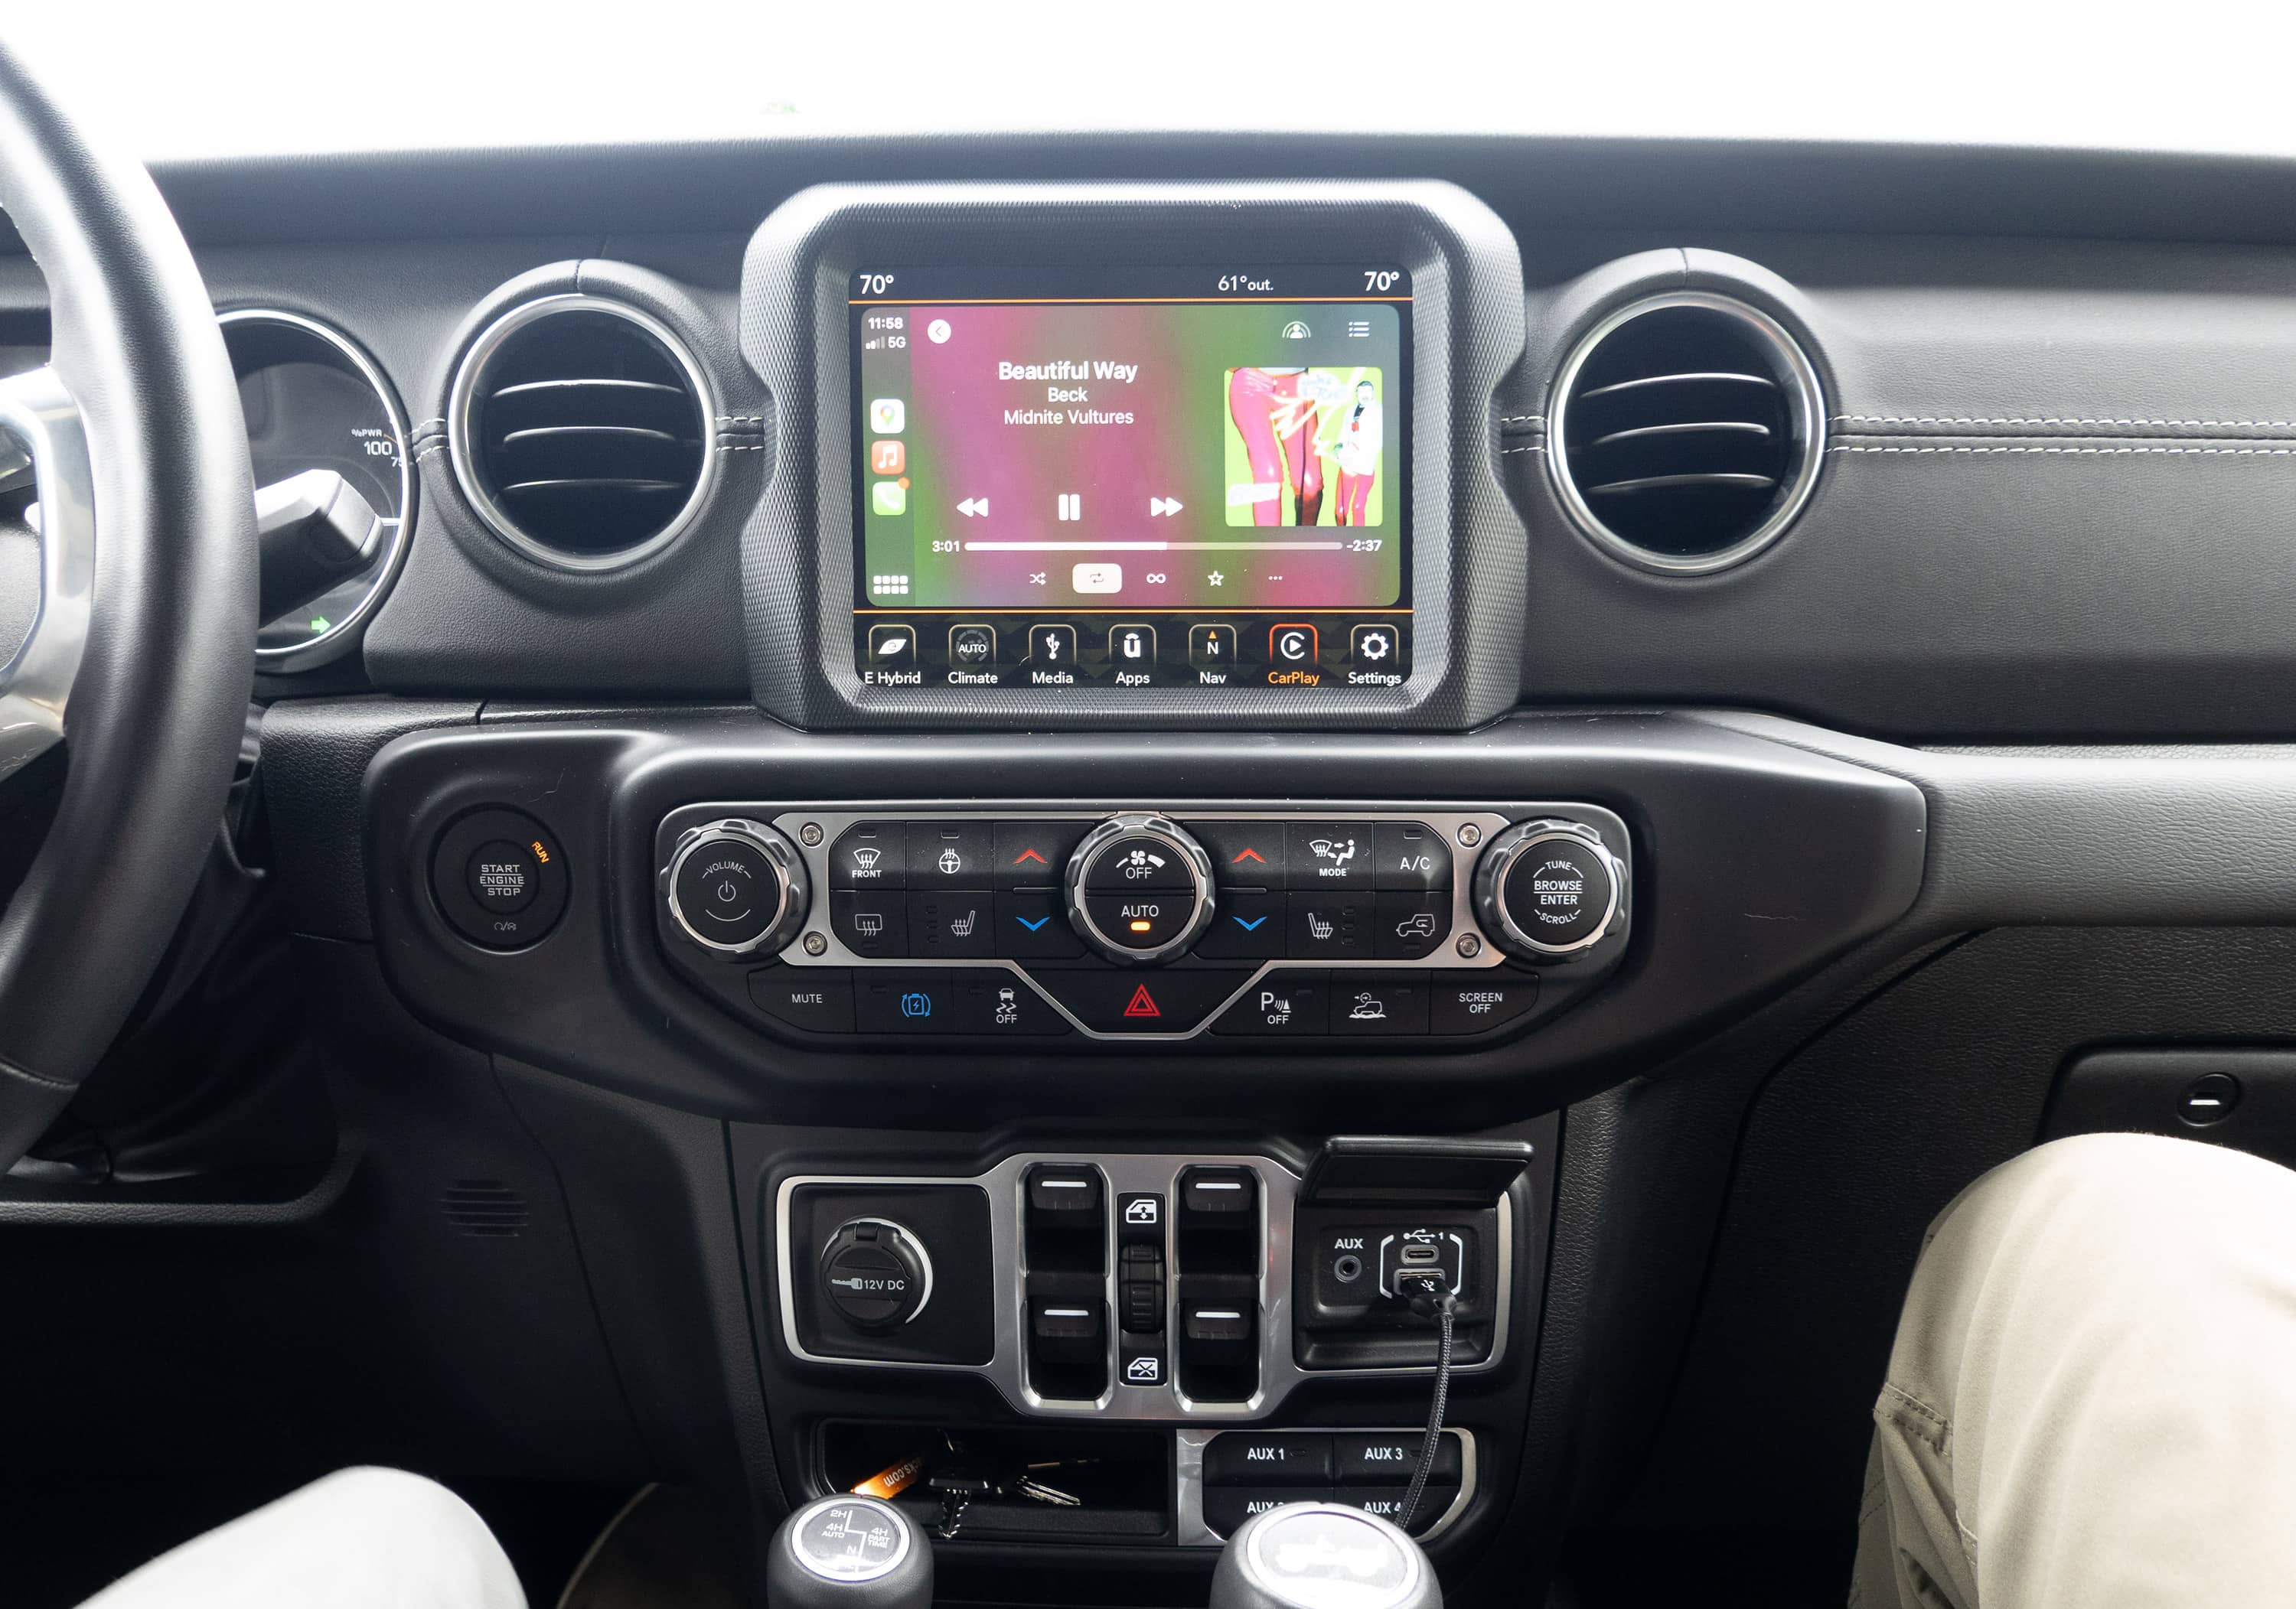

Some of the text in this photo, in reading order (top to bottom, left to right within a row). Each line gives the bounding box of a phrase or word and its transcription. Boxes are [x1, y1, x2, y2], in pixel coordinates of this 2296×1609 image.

[859, 275, 894, 295] 70°
[1365, 272, 1400, 291] 70°
[868, 318, 903, 330] 11:58
[888, 337, 906, 348] 5G
[999, 361, 1138, 383] Beautiful Way
[1048, 387, 1088, 402] Beck
[1004, 409, 1134, 425] Midnite Vultures
[364, 441, 393, 455] 100
[931, 541, 960, 552] 3:01
[1346, 540, 1383, 552] -2:37
[958, 643, 987, 653] AUTO
[1207, 642, 1218, 655] N
[865, 672, 921, 687] E Hybrid
[948, 672, 998, 684] Climate
[1032, 672, 1074, 684] Media
[1116, 672, 1150, 687] Apps
[1199, 673, 1226, 684] Nav
[1267, 672, 1320, 687] CarPlay
[1348, 672, 1401, 687] Settings
[531, 841, 550, 864] RUN
[481, 864, 520, 873] START
[706, 861, 746, 875] VOLUME
[1400, 855, 1430, 871] A/C
[1545, 860, 1573, 871] TUNE
[851, 869, 882, 878] FRONT
[1126, 867, 1153, 879] OFF
[1319, 868, 1347, 877] MODE
[479, 876, 525, 884] ENGINE
[1533, 880, 1583, 891] BROWSE
[488, 888, 521, 896] STOP
[1540, 894, 1578, 905] ENTER
[1120, 905, 1159, 917] AUTO
[1539, 913, 1577, 925] SCROLL
[791, 994, 823, 1003] MUTE
[1459, 992, 1503, 1002] SCREEN
[1469, 1004, 1491, 1014] OFF
[996, 1014, 1017, 1024] OFF
[1267, 1015, 1289, 1025] OFF
[1438, 1232, 1444, 1240] 1
[1334, 1238, 1363, 1249] AUX
[863, 1280, 905, 1291] 12V DC
[1247, 1448, 1285, 1461] AUX 1
[1364, 1448, 1403, 1461] AUX 3
[1363, 1502, 1391, 1513] AUX
[830, 1510, 847, 1519] 2H
[826, 1523, 843, 1532] 4H
[870, 1527, 888, 1536] 4H
[821, 1530, 845, 1539] AUTO
[867, 1533, 891, 1542] PART
[846, 1545, 856, 1555] N
[868, 1540, 888, 1549] TIME
